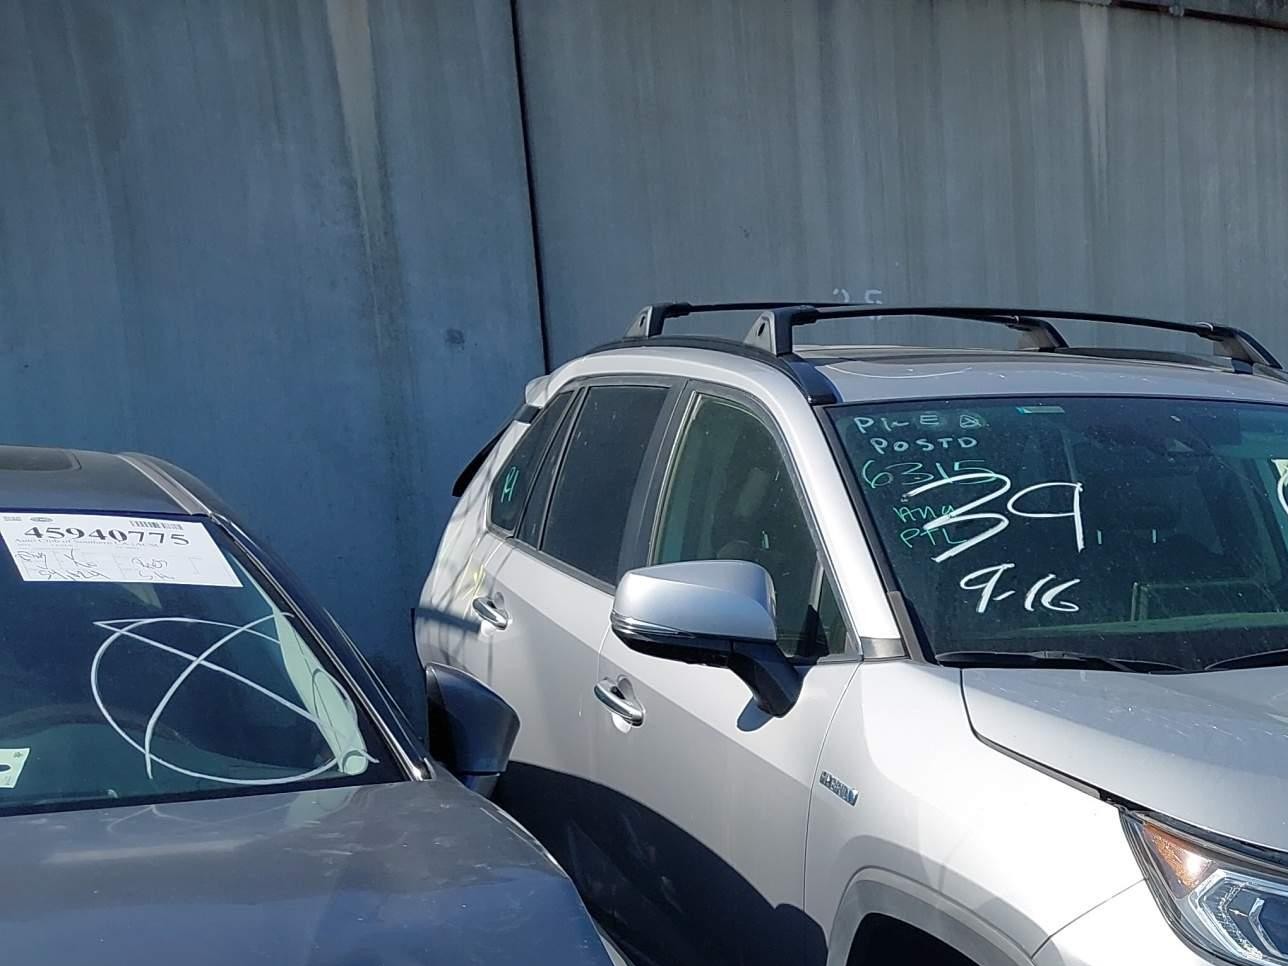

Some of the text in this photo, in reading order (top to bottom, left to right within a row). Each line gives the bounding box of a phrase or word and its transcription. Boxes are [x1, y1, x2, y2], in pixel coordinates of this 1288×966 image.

[870, 437, 977, 455] POSTD
[862, 460, 998, 489] 6315
[902, 472, 1085, 563] 39
[24, 526, 190, 546] 45940775
[960, 563, 1080, 613] 9-16
